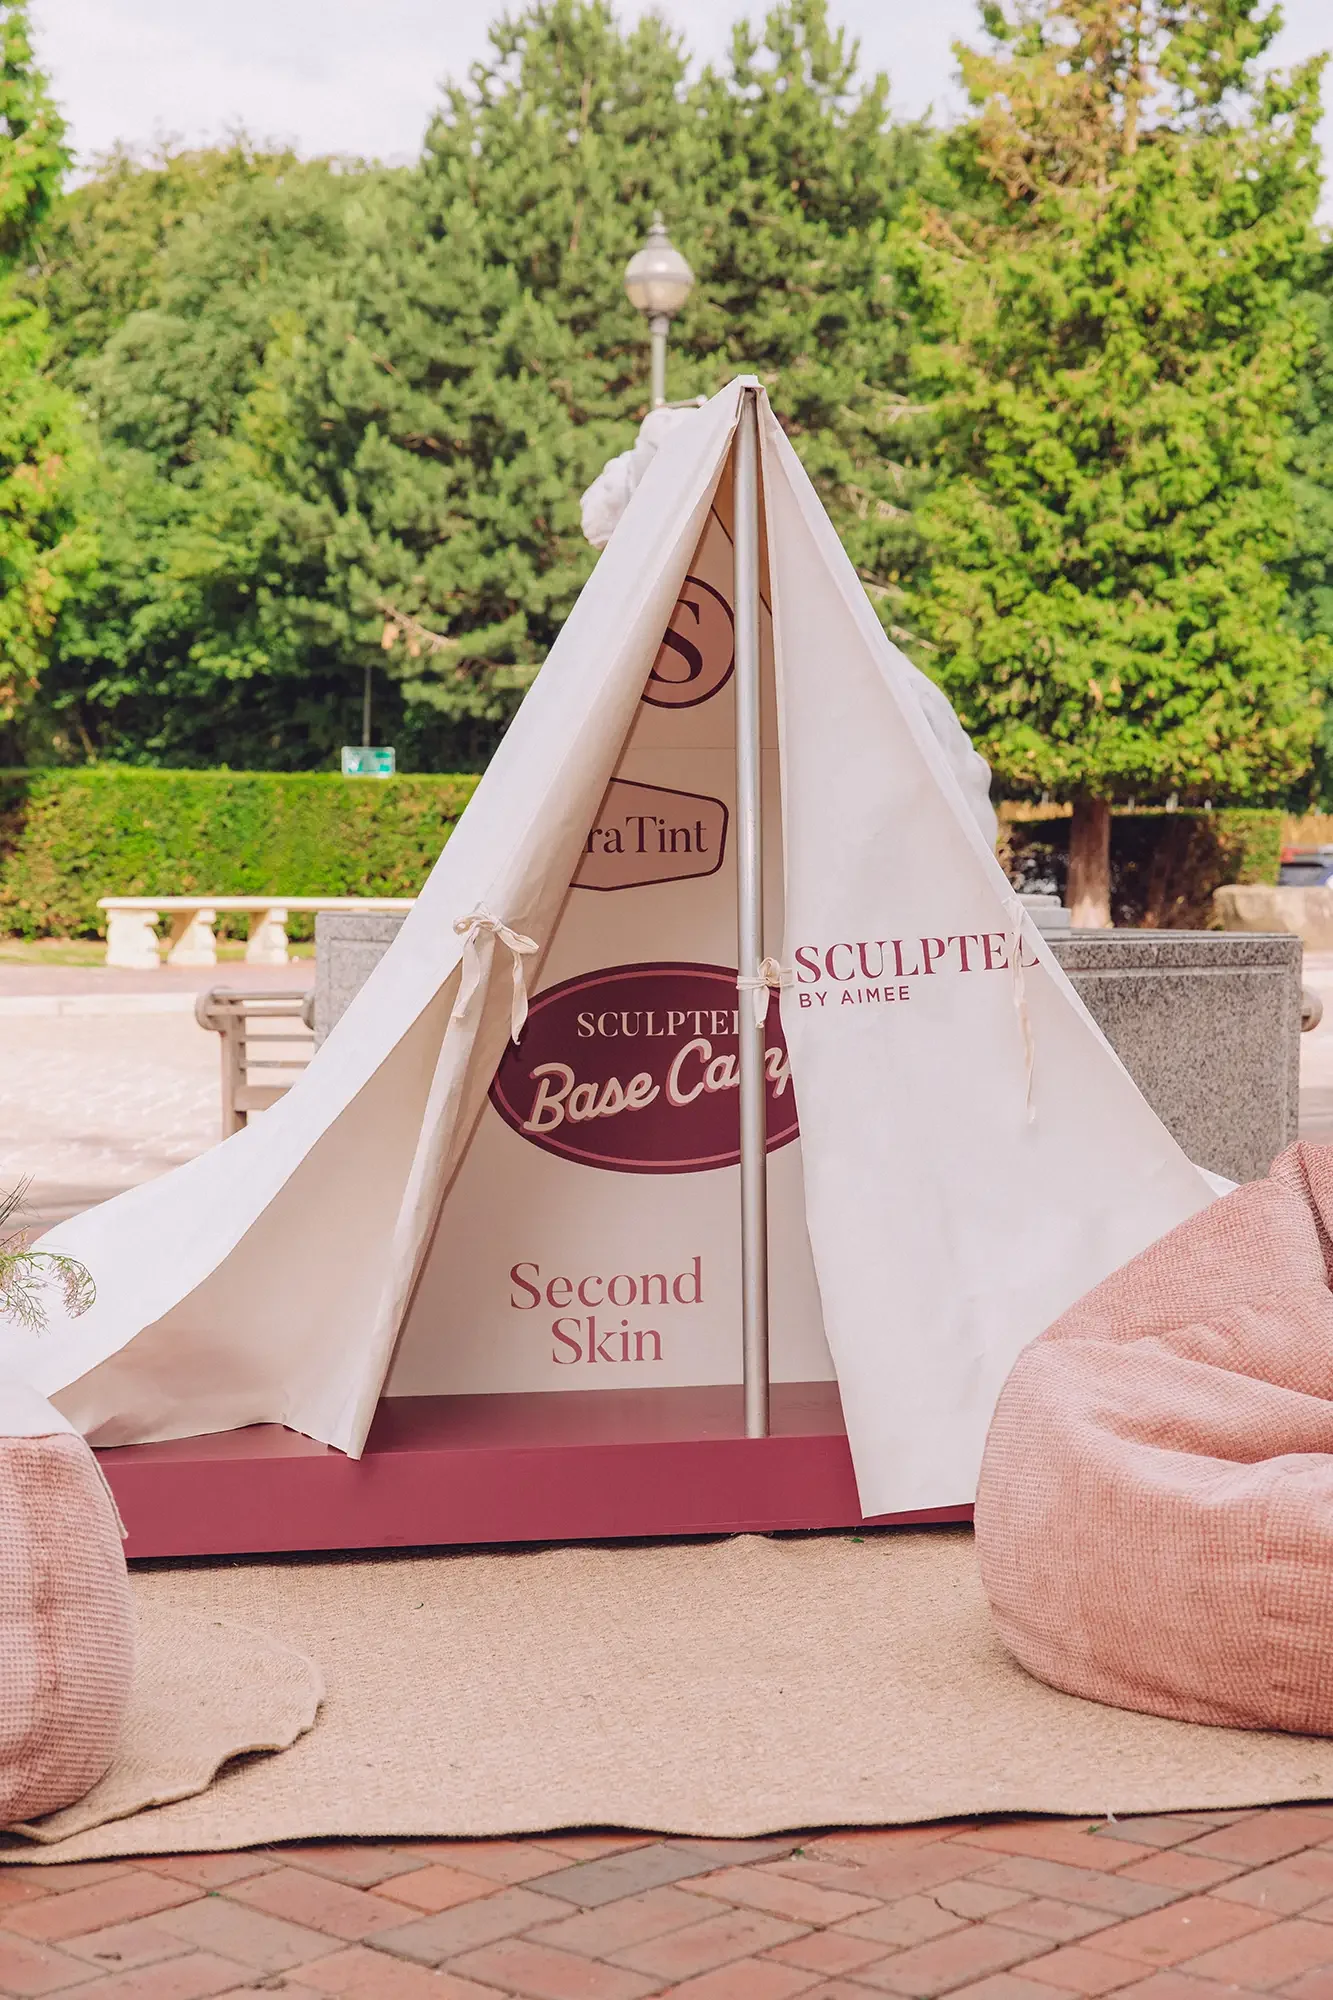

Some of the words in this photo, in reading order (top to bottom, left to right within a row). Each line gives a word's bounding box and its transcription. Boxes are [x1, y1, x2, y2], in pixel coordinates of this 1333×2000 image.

[649, 598, 703, 684] S
[582, 815, 709, 854] raTint
[798, 991, 828, 1009] BY
[840, 985, 911, 1006] AIMEE
[520, 1062, 661, 1134] Base
[509, 1255, 705, 1310] Second
[551, 1315, 664, 1365] Skin
